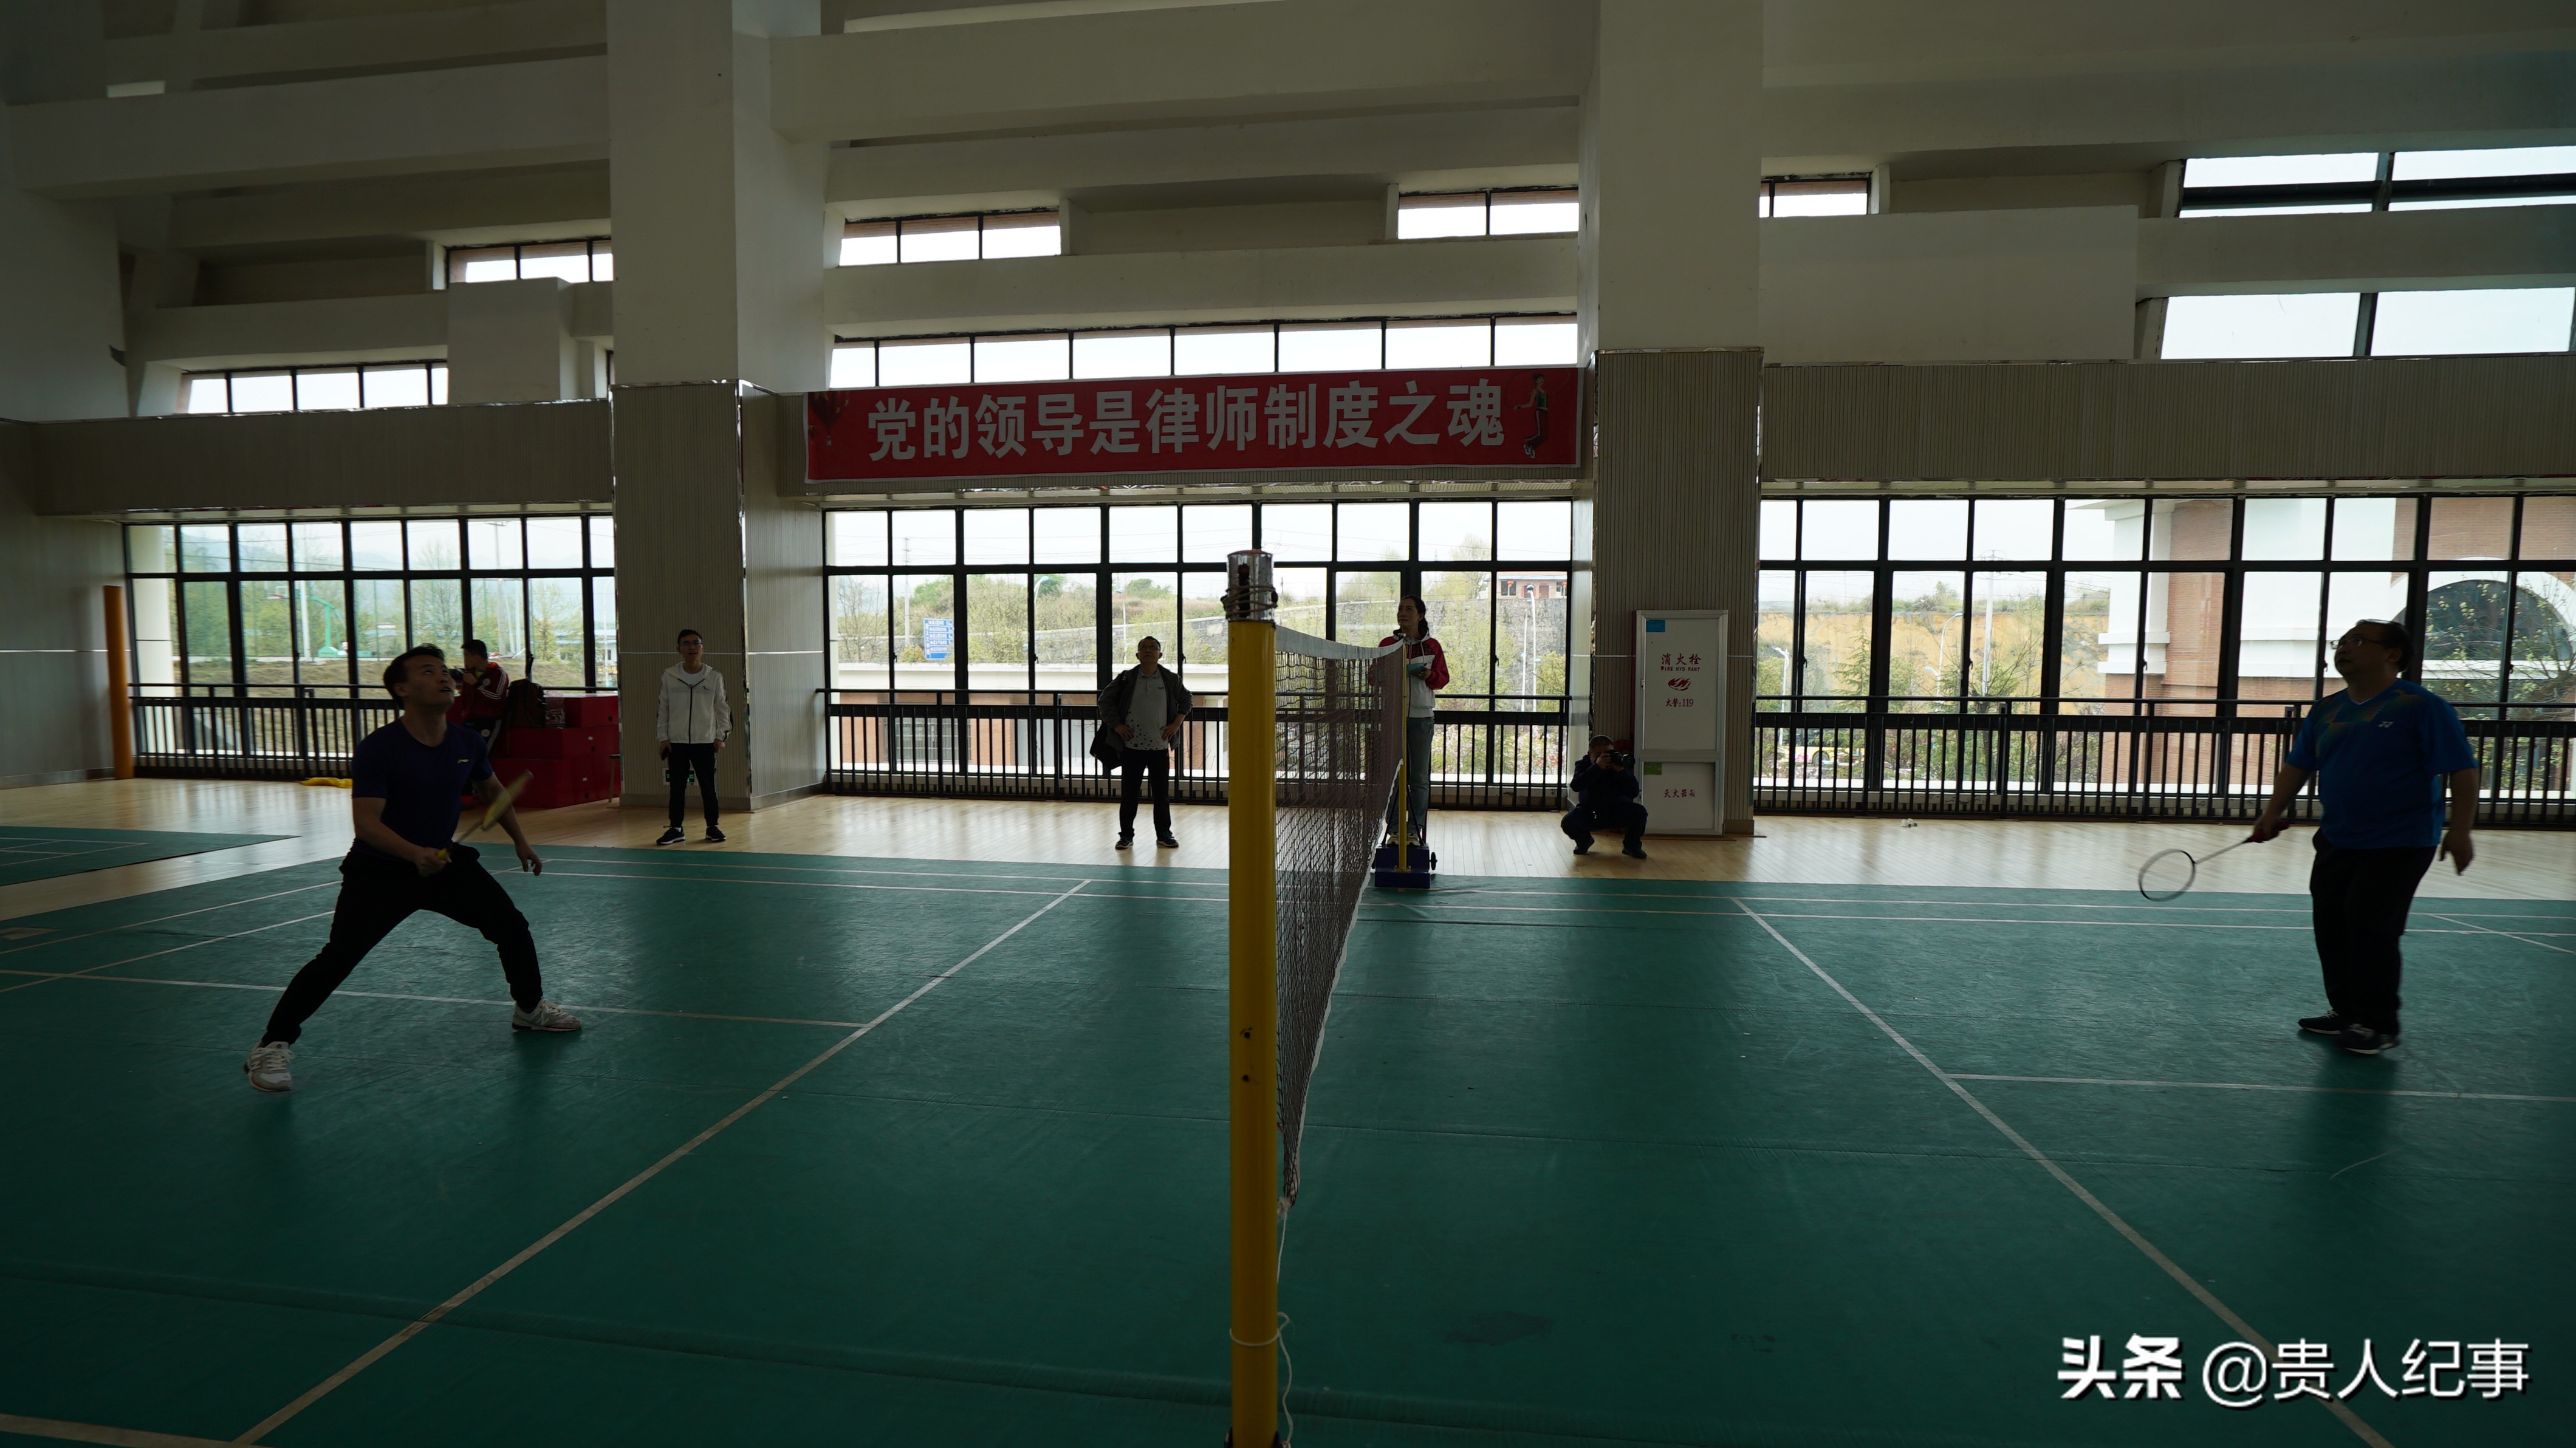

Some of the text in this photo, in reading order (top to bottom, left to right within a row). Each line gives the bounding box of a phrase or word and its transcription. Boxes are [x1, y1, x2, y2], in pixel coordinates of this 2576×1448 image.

[868, 378, 1505, 462] 党的领导是律师制度之魂
[1662, 653, 1702, 666] 消火栓
